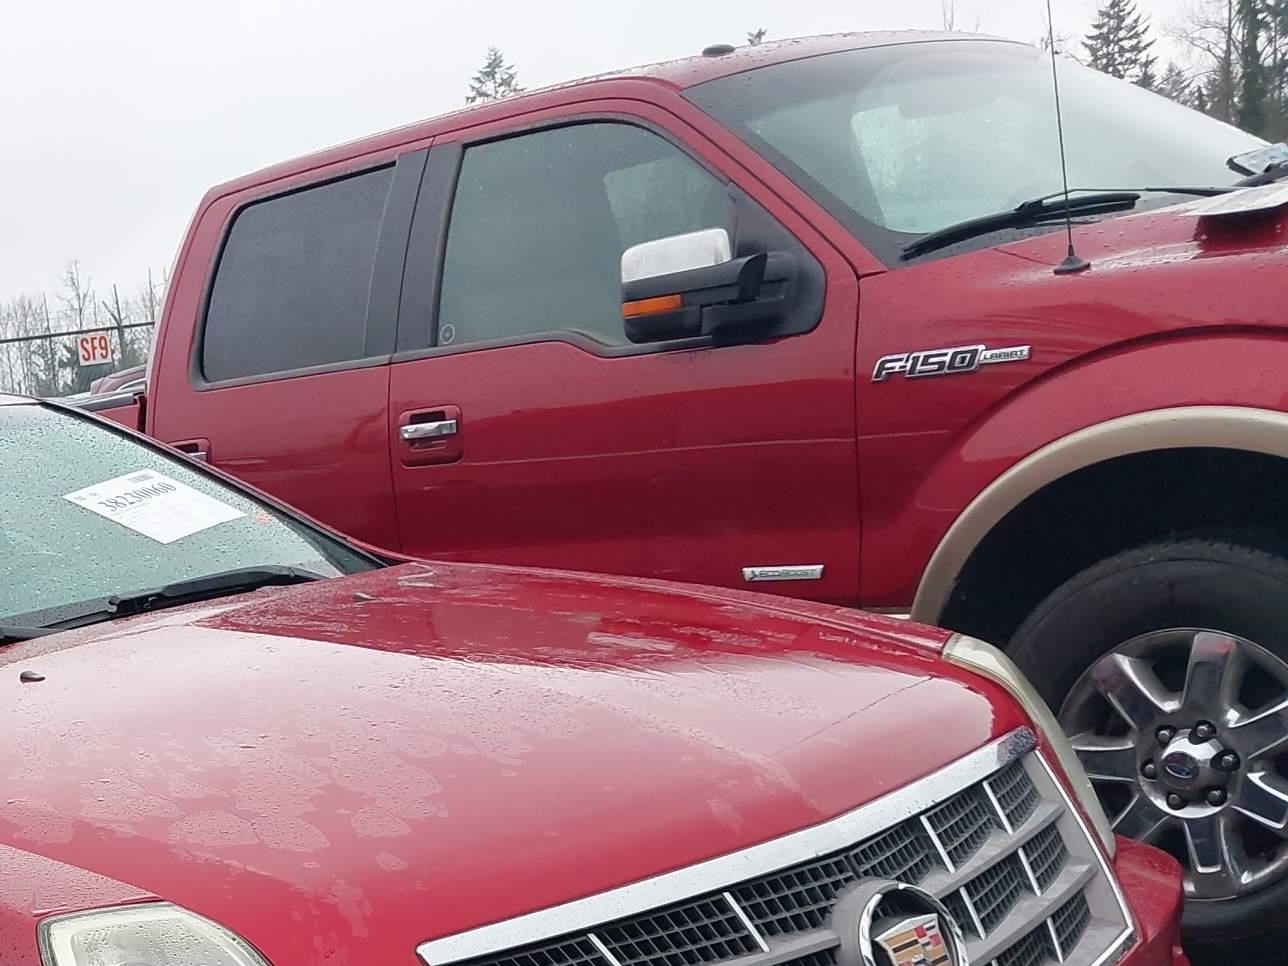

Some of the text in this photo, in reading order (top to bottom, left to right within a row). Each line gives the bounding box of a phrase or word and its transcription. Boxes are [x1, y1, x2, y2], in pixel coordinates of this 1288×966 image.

[80, 335, 108, 362] SF9
[871, 345, 1027, 382] F-150 LARIAT
[97, 482, 177, 512] 38230060
